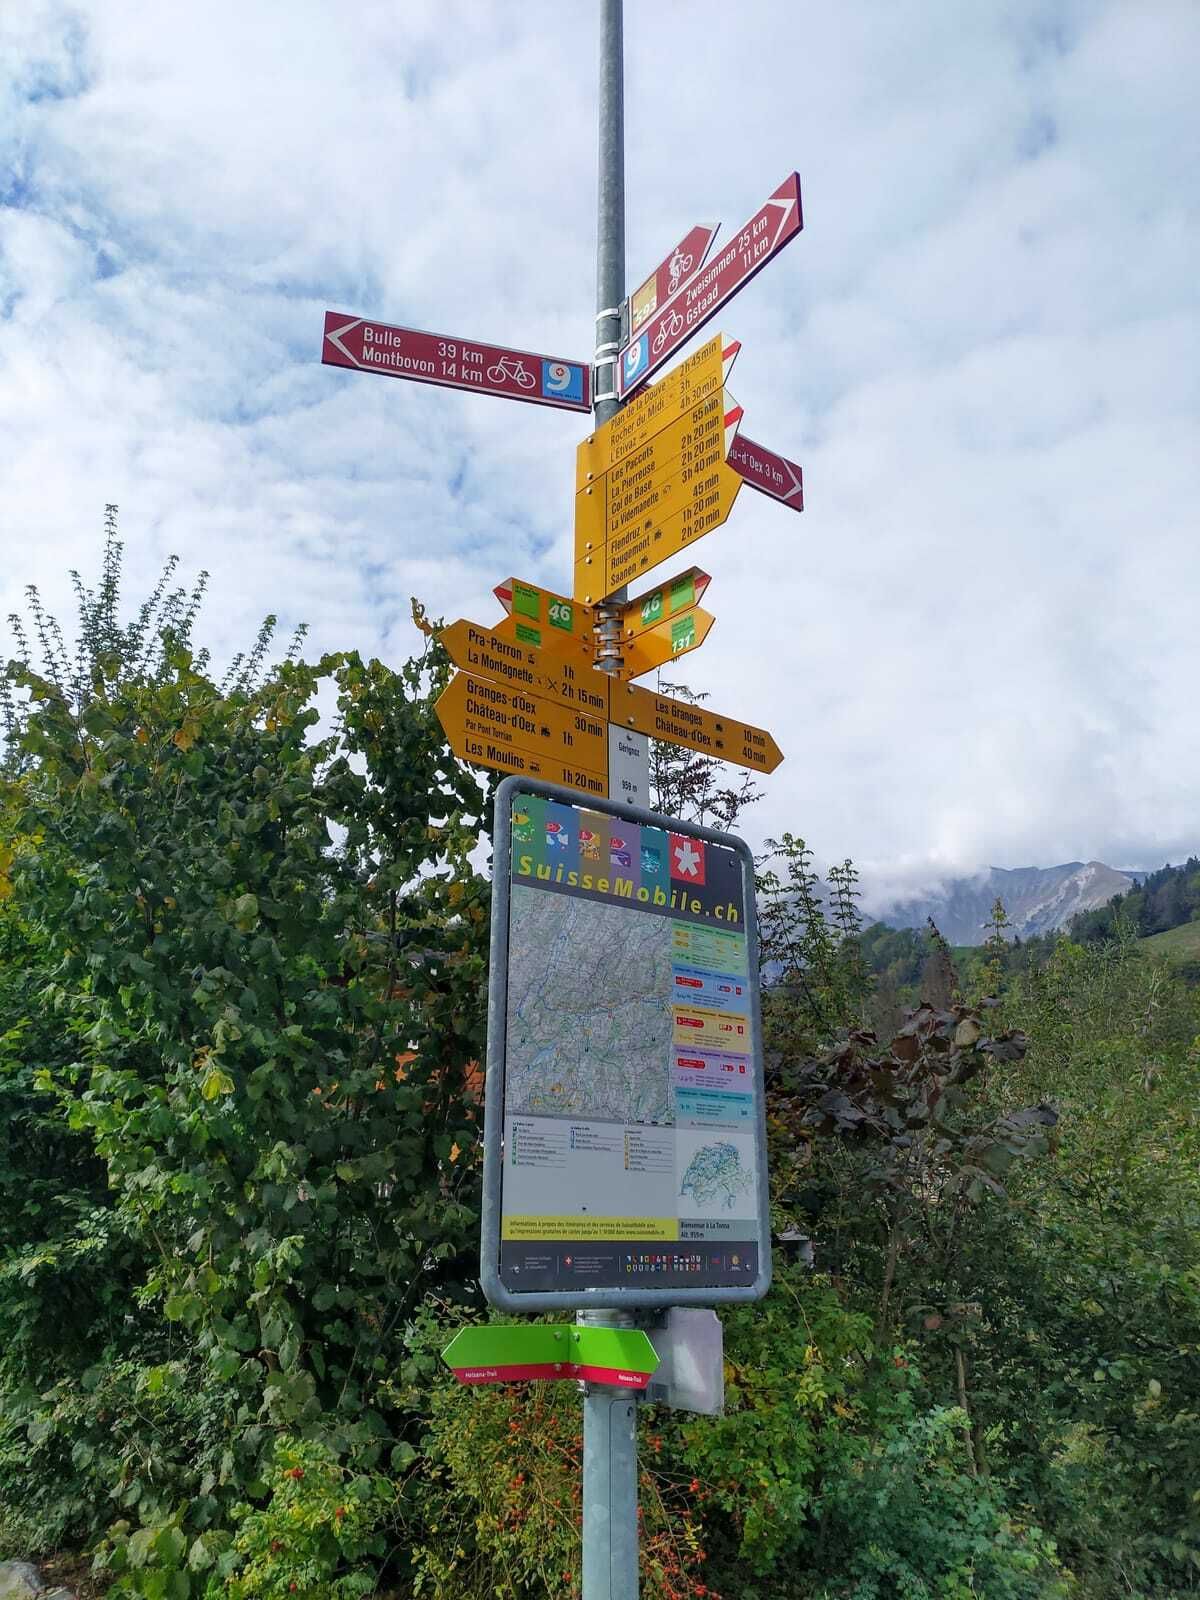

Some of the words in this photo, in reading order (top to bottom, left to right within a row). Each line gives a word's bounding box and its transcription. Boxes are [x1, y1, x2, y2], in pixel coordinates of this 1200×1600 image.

[686, 248, 736, 305] Zweisimmen
[738, 229, 750, 249] 25
[753, 215, 768, 237] km
[686, 285, 719, 324] Gstaad
[743, 249, 752, 268] 11
[753, 236, 769, 258] km
[363, 327, 401, 348] Bulle
[438, 342, 457, 359] 39
[462, 347, 483, 365] km
[627, 340, 641, 378] 9
[362, 346, 435, 373] Montbovon
[441, 362, 458, 377] 14
[461, 365, 483, 382] km
[546, 363, 571, 391] 9
[611, 465, 623, 483] Les
[772, 467, 784, 485] km
[611, 486, 620, 499] La
[611, 499, 623, 515] Col
[624, 493, 634, 506] de
[611, 517, 620, 531] La
[611, 535, 651, 570] Rougemont
[610, 563, 637, 586] Saanen
[548, 604, 571, 621] 46
[468, 628, 522, 660] Pra-Perron
[467, 648, 478, 663] La
[481, 652, 534, 685] Montagnette
[466, 698, 536, 735] Château-d'Oex
[655, 698, 669, 714] Les
[671, 702, 704, 727] Granges
[465, 739, 483, 757] Les
[486, 745, 525, 769] Moulins
[518, 855, 739, 923] SuisseMobile.ch
